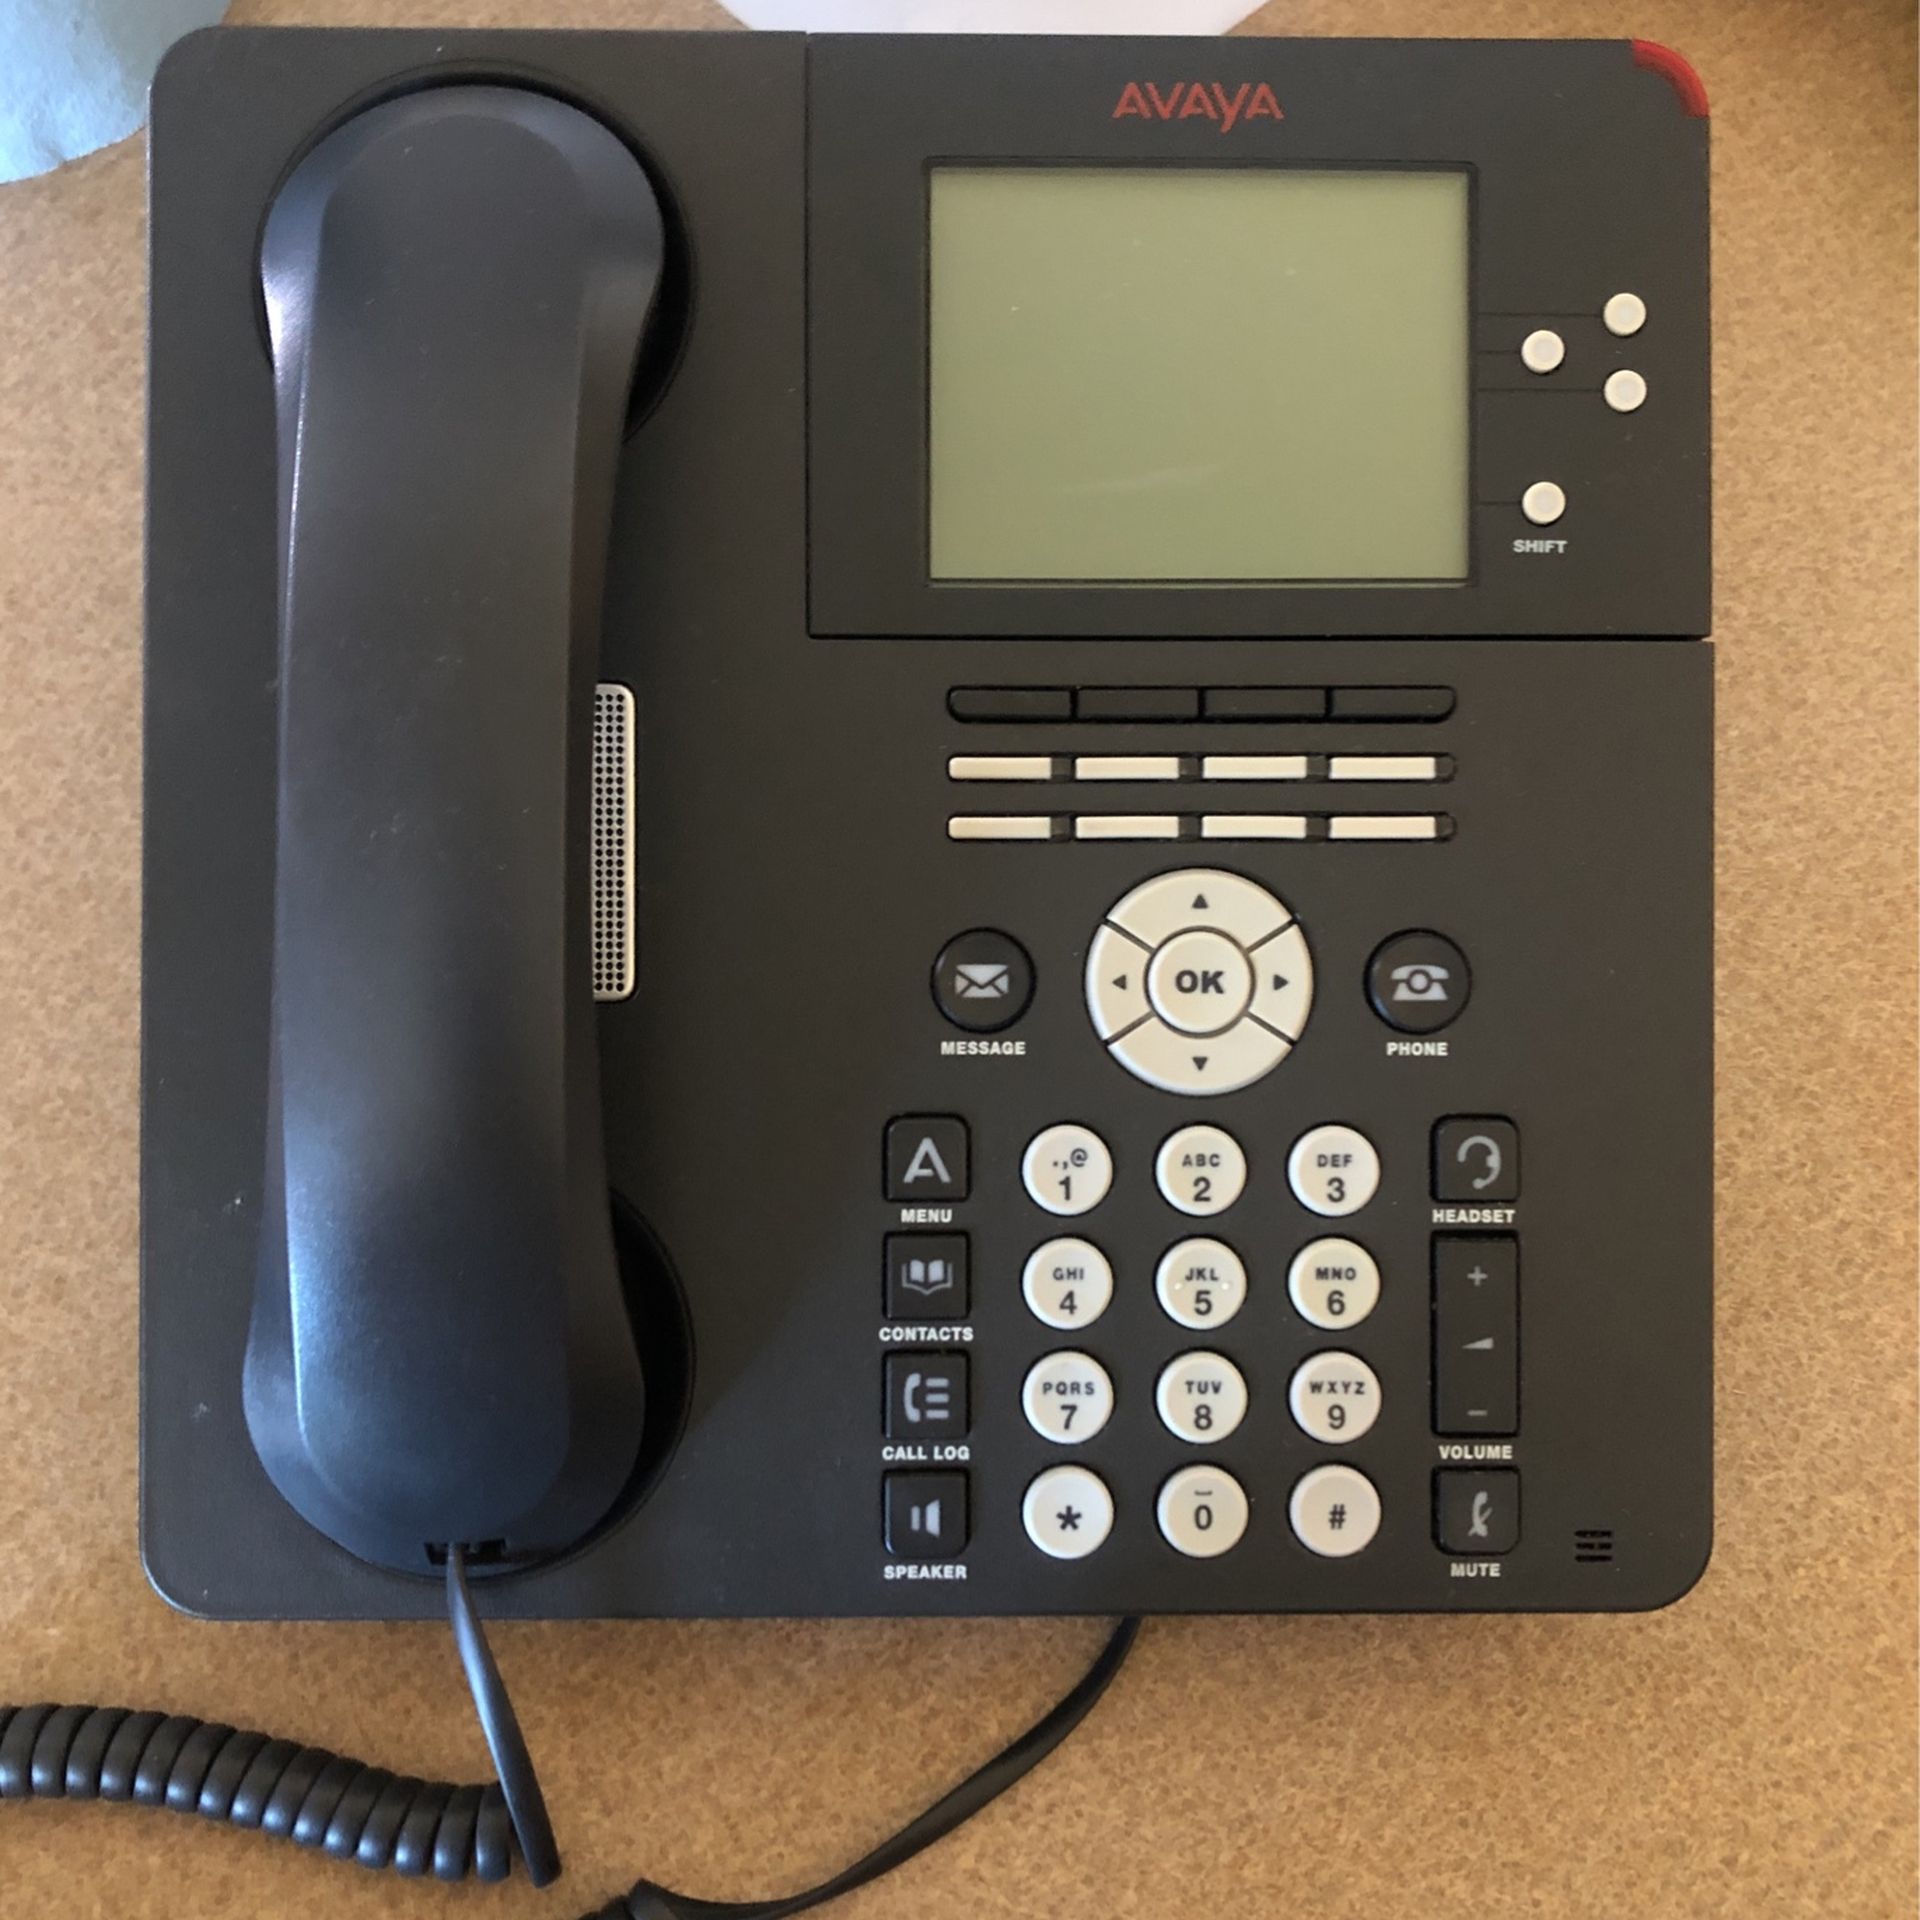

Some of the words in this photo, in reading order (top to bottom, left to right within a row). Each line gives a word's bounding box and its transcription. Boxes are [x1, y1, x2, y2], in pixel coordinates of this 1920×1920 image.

[1113, 82, 1284, 134] AVAYA
[1513, 539, 1568, 554] SHIFT
[1174, 969, 1225, 995] OK
[941, 1041, 1026, 1055] MESSAGE
[1386, 1041, 1448, 1056] PHONE
[1181, 1153, 1221, 1168] ABC
[1317, 1153, 1352, 1169] DEF
[1058, 1175, 1071, 1202] 1
[1193, 1176, 1212, 1203] 2
[1326, 1176, 1346, 1204] 3
[900, 1208, 953, 1223] MENU
[1432, 1209, 1516, 1224] HEADSET
[1052, 1267, 1084, 1281] GHI
[1184, 1267, 1219, 1282] JKL
[1315, 1267, 1356, 1281] MNO
[1059, 1290, 1078, 1315] 4
[1194, 1289, 1213, 1317] 5
[1326, 1289, 1346, 1316] 6
[878, 1326, 974, 1342] CONTACTS
[1042, 1381, 1095, 1396] PQRS
[1185, 1380, 1222, 1395] TUV
[1309, 1381, 1365, 1396] WXYZ
[1060, 1403, 1078, 1431] 7
[1193, 1404, 1213, 1431] 8
[1327, 1403, 1346, 1431] 9
[881, 1445, 928, 1461] CALL
[933, 1445, 970, 1461] LOG
[1438, 1445, 1513, 1460] VOLUME
[1194, 1504, 1213, 1531] 0
[1328, 1503, 1347, 1530] #
[883, 1564, 967, 1580] SPEAKER
[1450, 1562, 1501, 1578] MUTE
